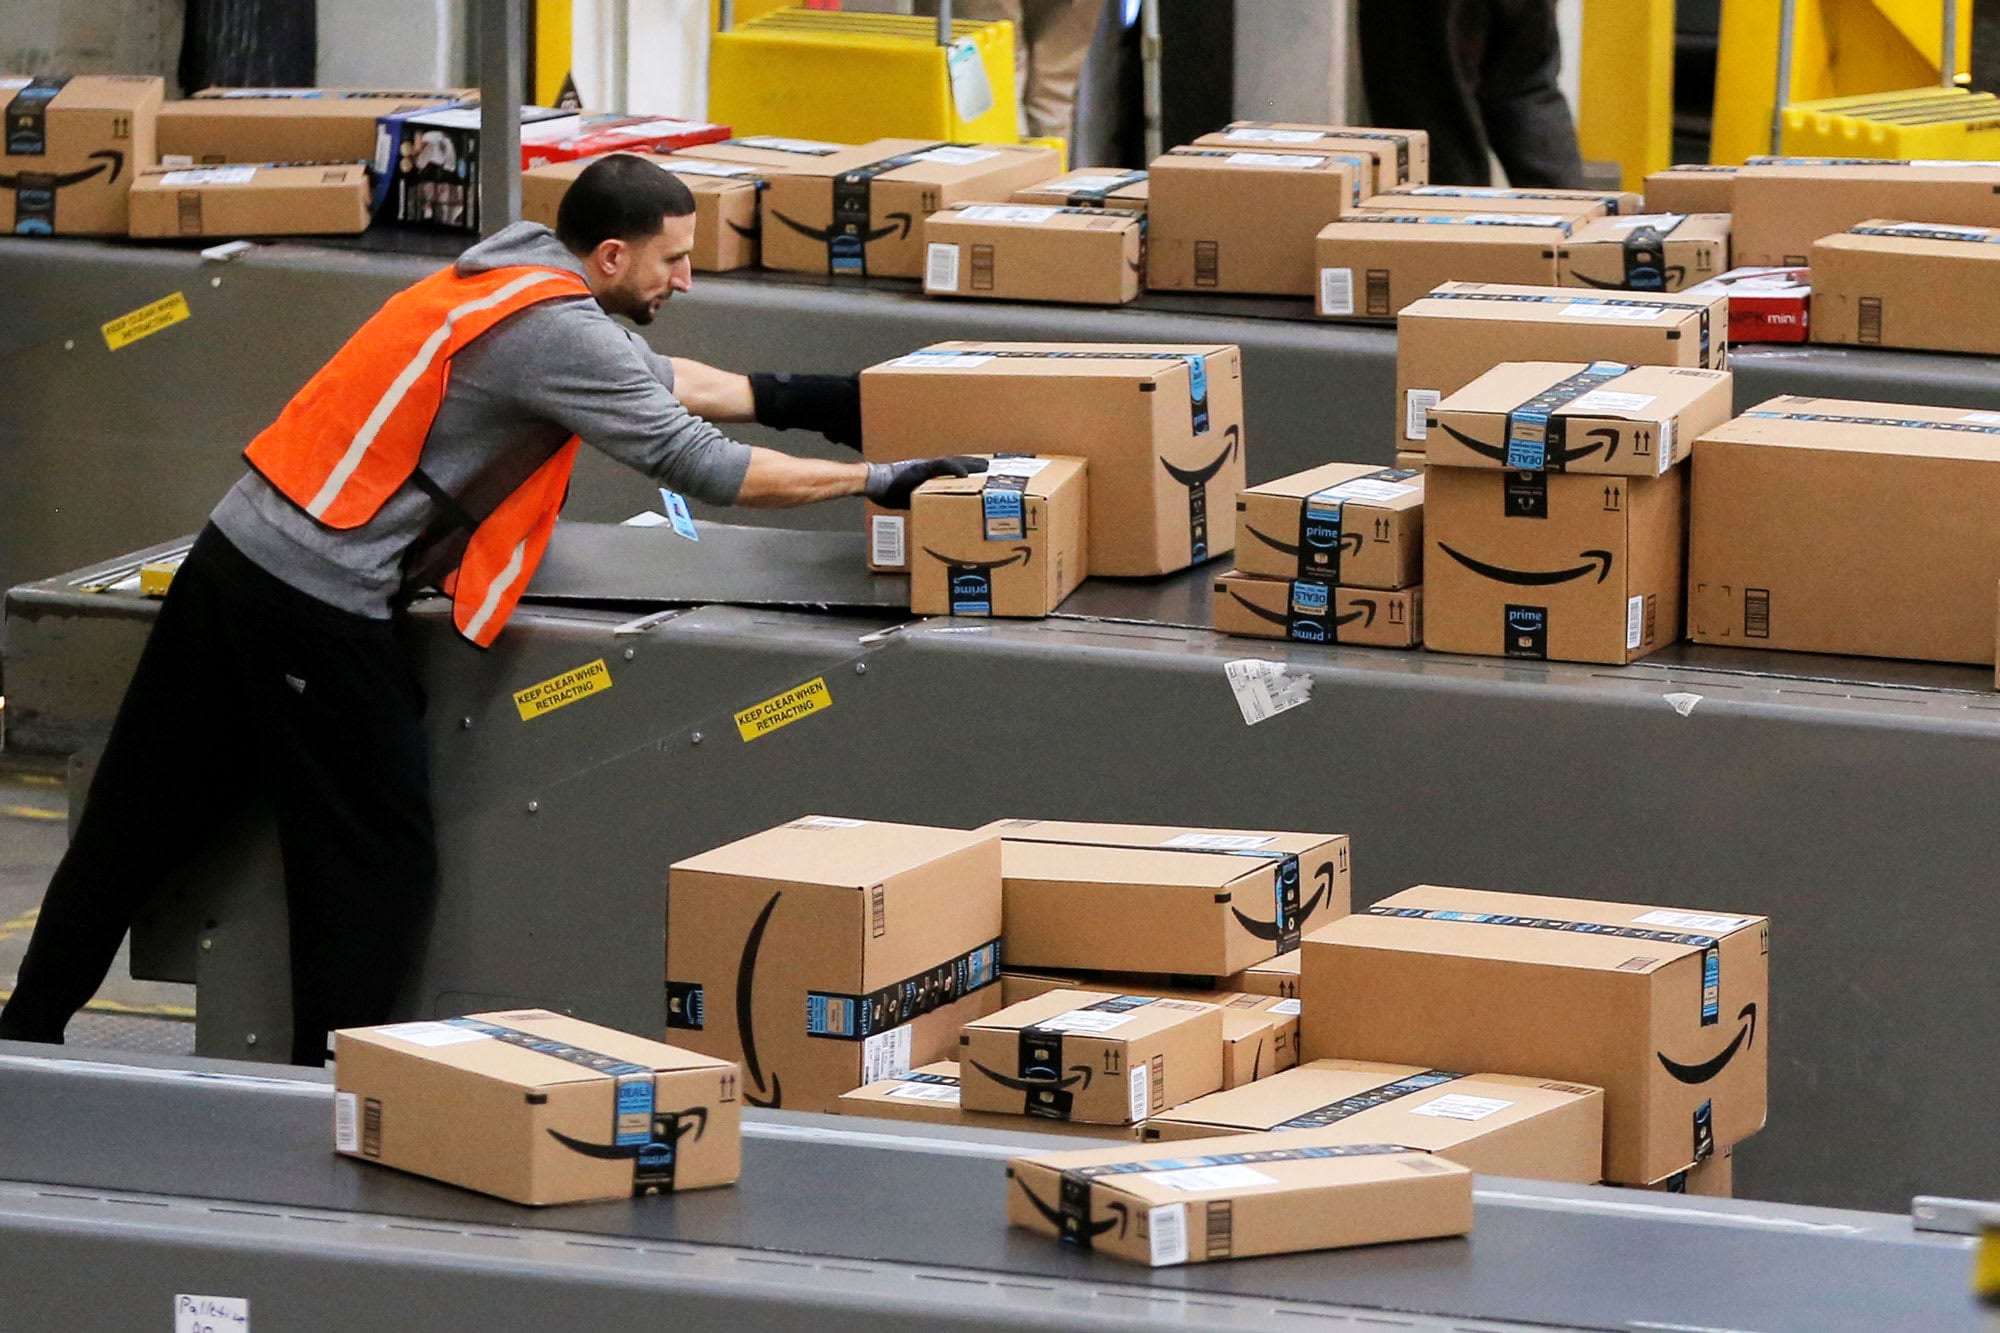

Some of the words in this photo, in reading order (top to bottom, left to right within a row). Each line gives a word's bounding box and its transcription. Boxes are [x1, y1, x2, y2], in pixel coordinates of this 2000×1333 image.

[1767, 313, 1796, 324] mini
[1509, 454, 1542, 466] DEALS
[985, 495, 1019, 505] DEALS
[1306, 525, 1338, 539] prime
[954, 583, 988, 597] prime
[1295, 590, 1326, 604] DEALS
[1509, 609, 1542, 621] prime
[517, 688, 541, 704] KEEP
[544, 675, 575, 694] CLEAR
[574, 663, 603, 681] WHEN
[535, 681, 594, 711] RETRACTING
[738, 709, 762, 725] KEEP
[764, 694, 795, 714] CLEAR
[795, 682, 823, 700] WHEN
[756, 700, 814, 731] RETRACTING
[860, 1000, 868, 1036] prime
